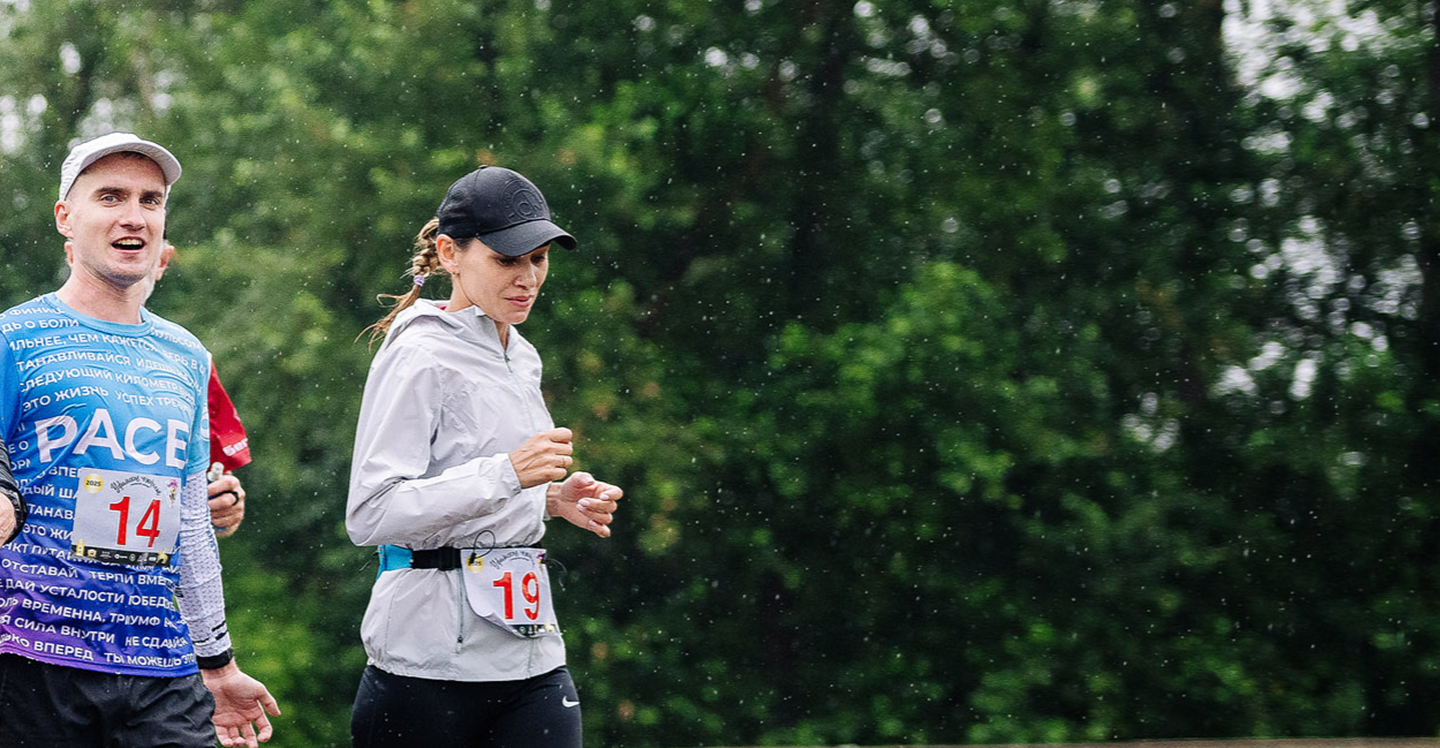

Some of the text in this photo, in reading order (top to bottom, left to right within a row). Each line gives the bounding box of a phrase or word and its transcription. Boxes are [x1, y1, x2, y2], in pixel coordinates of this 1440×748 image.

[24, 320, 36, 329] О
[39, 318, 80, 329] БОЛИ
[68, 333, 99, 343] ЧЕМ
[22, 395, 52, 412] ЭТО
[54, 385, 109, 402] ЖИЗНЬ
[114, 389, 155, 407] УСПЕХ
[34, 408, 190, 469] PACE
[22, 522, 47, 537] ЭТО
[109, 496, 161, 548] 14
[1, 558, 78, 579] ОТСТАВАЙ
[88, 570, 135, 585] ТЕРПИ
[5, 578, 36, 592] ДАЙ
[39, 584, 125, 604] УСТАЛОСТИ
[492, 571, 540, 621] 19
[21, 598, 107, 623] ВРЕМЕННА,
[14, 617, 57, 634] СИЛА
[60, 625, 116, 644] ВНУТРИ
[124, 635, 140, 647] НЕ
[33, 640, 95, 661] ВПЕРЕД
[103, 652, 125, 664] ТЫ
[126, 655, 182, 668] МОЖЕШЬ
